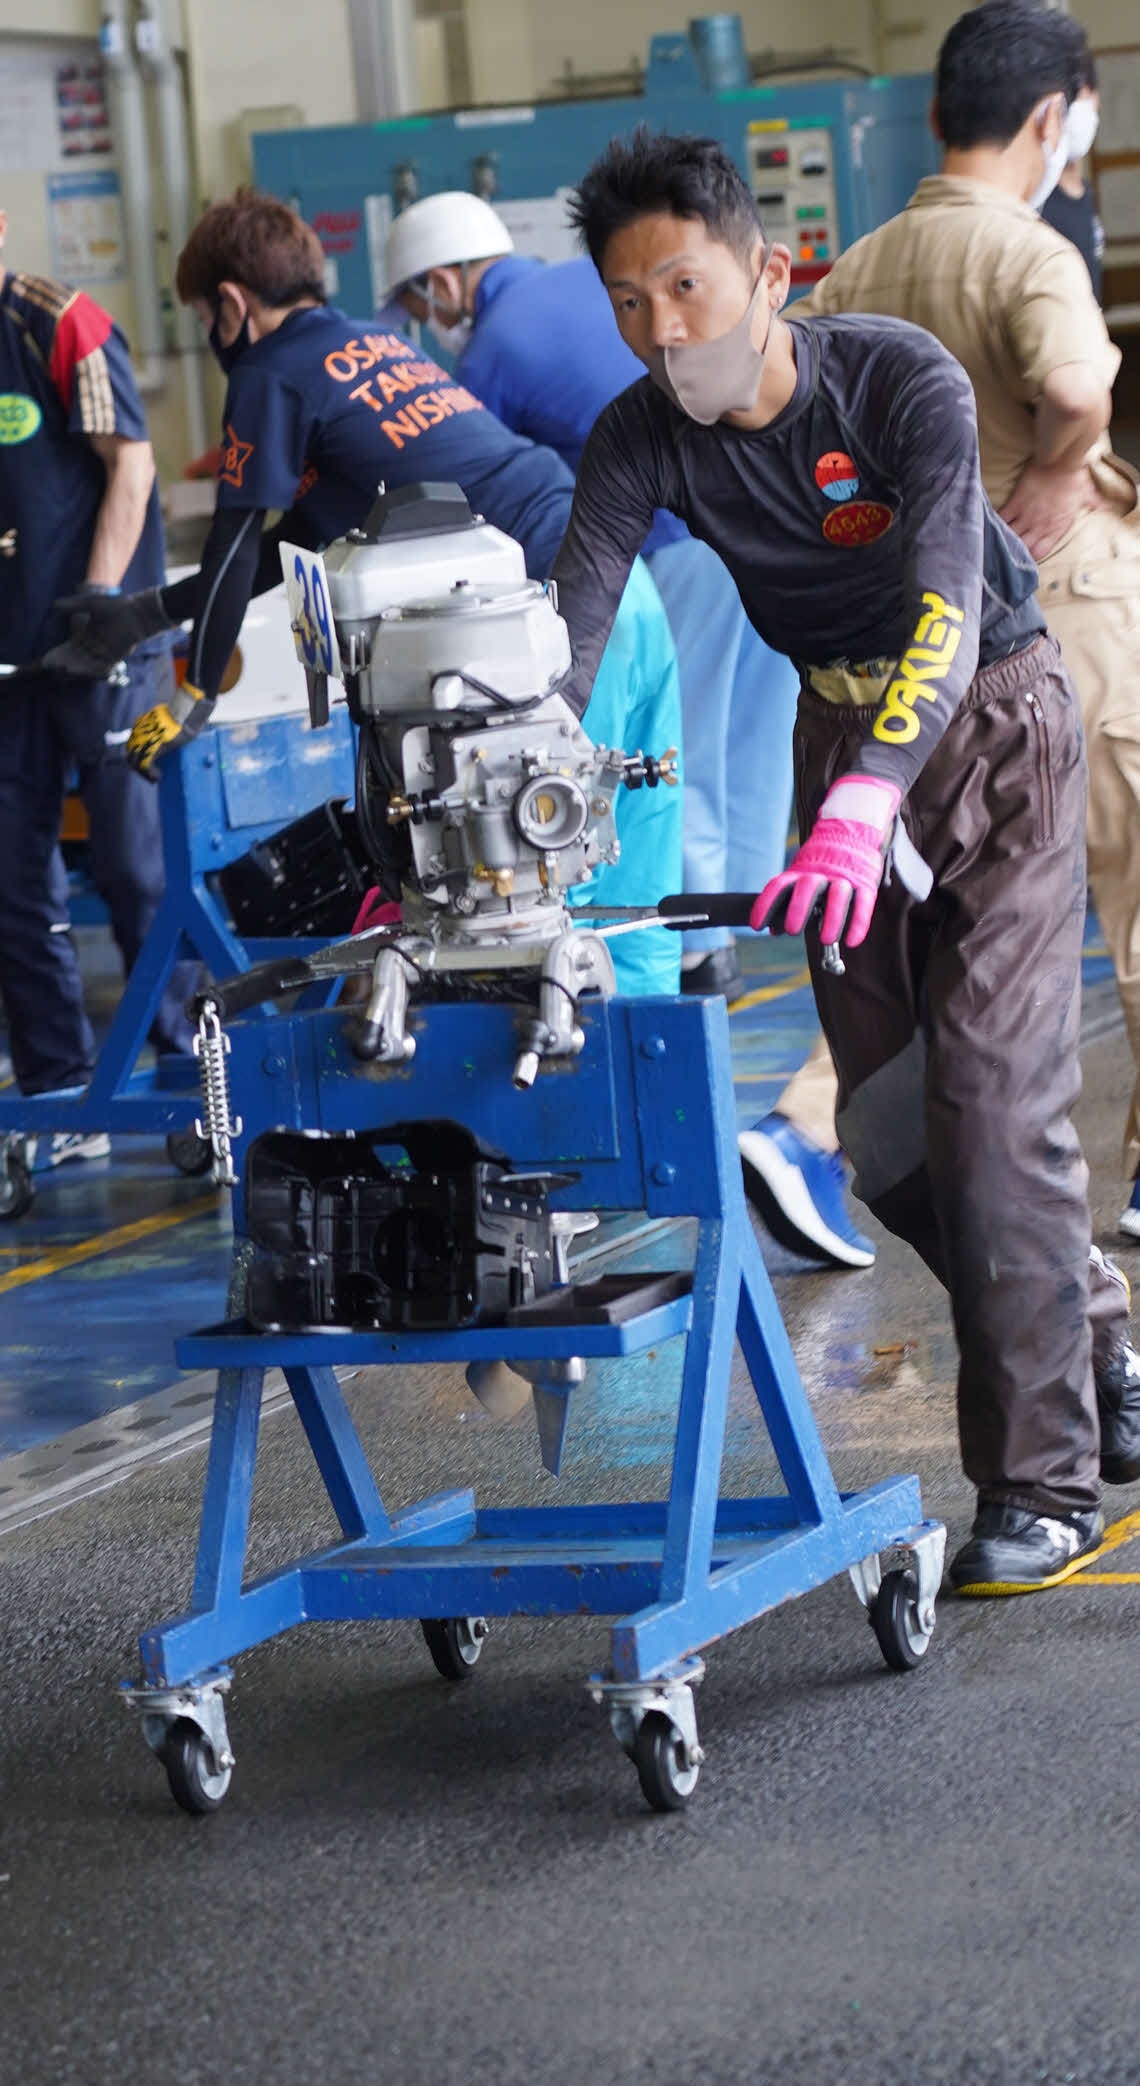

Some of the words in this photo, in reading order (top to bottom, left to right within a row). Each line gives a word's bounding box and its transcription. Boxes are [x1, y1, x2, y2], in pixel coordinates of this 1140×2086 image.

[348, 362, 451, 412] TAK
[380, 386, 484, 449] NISH
[872, 591, 965, 744] OAKLEY
